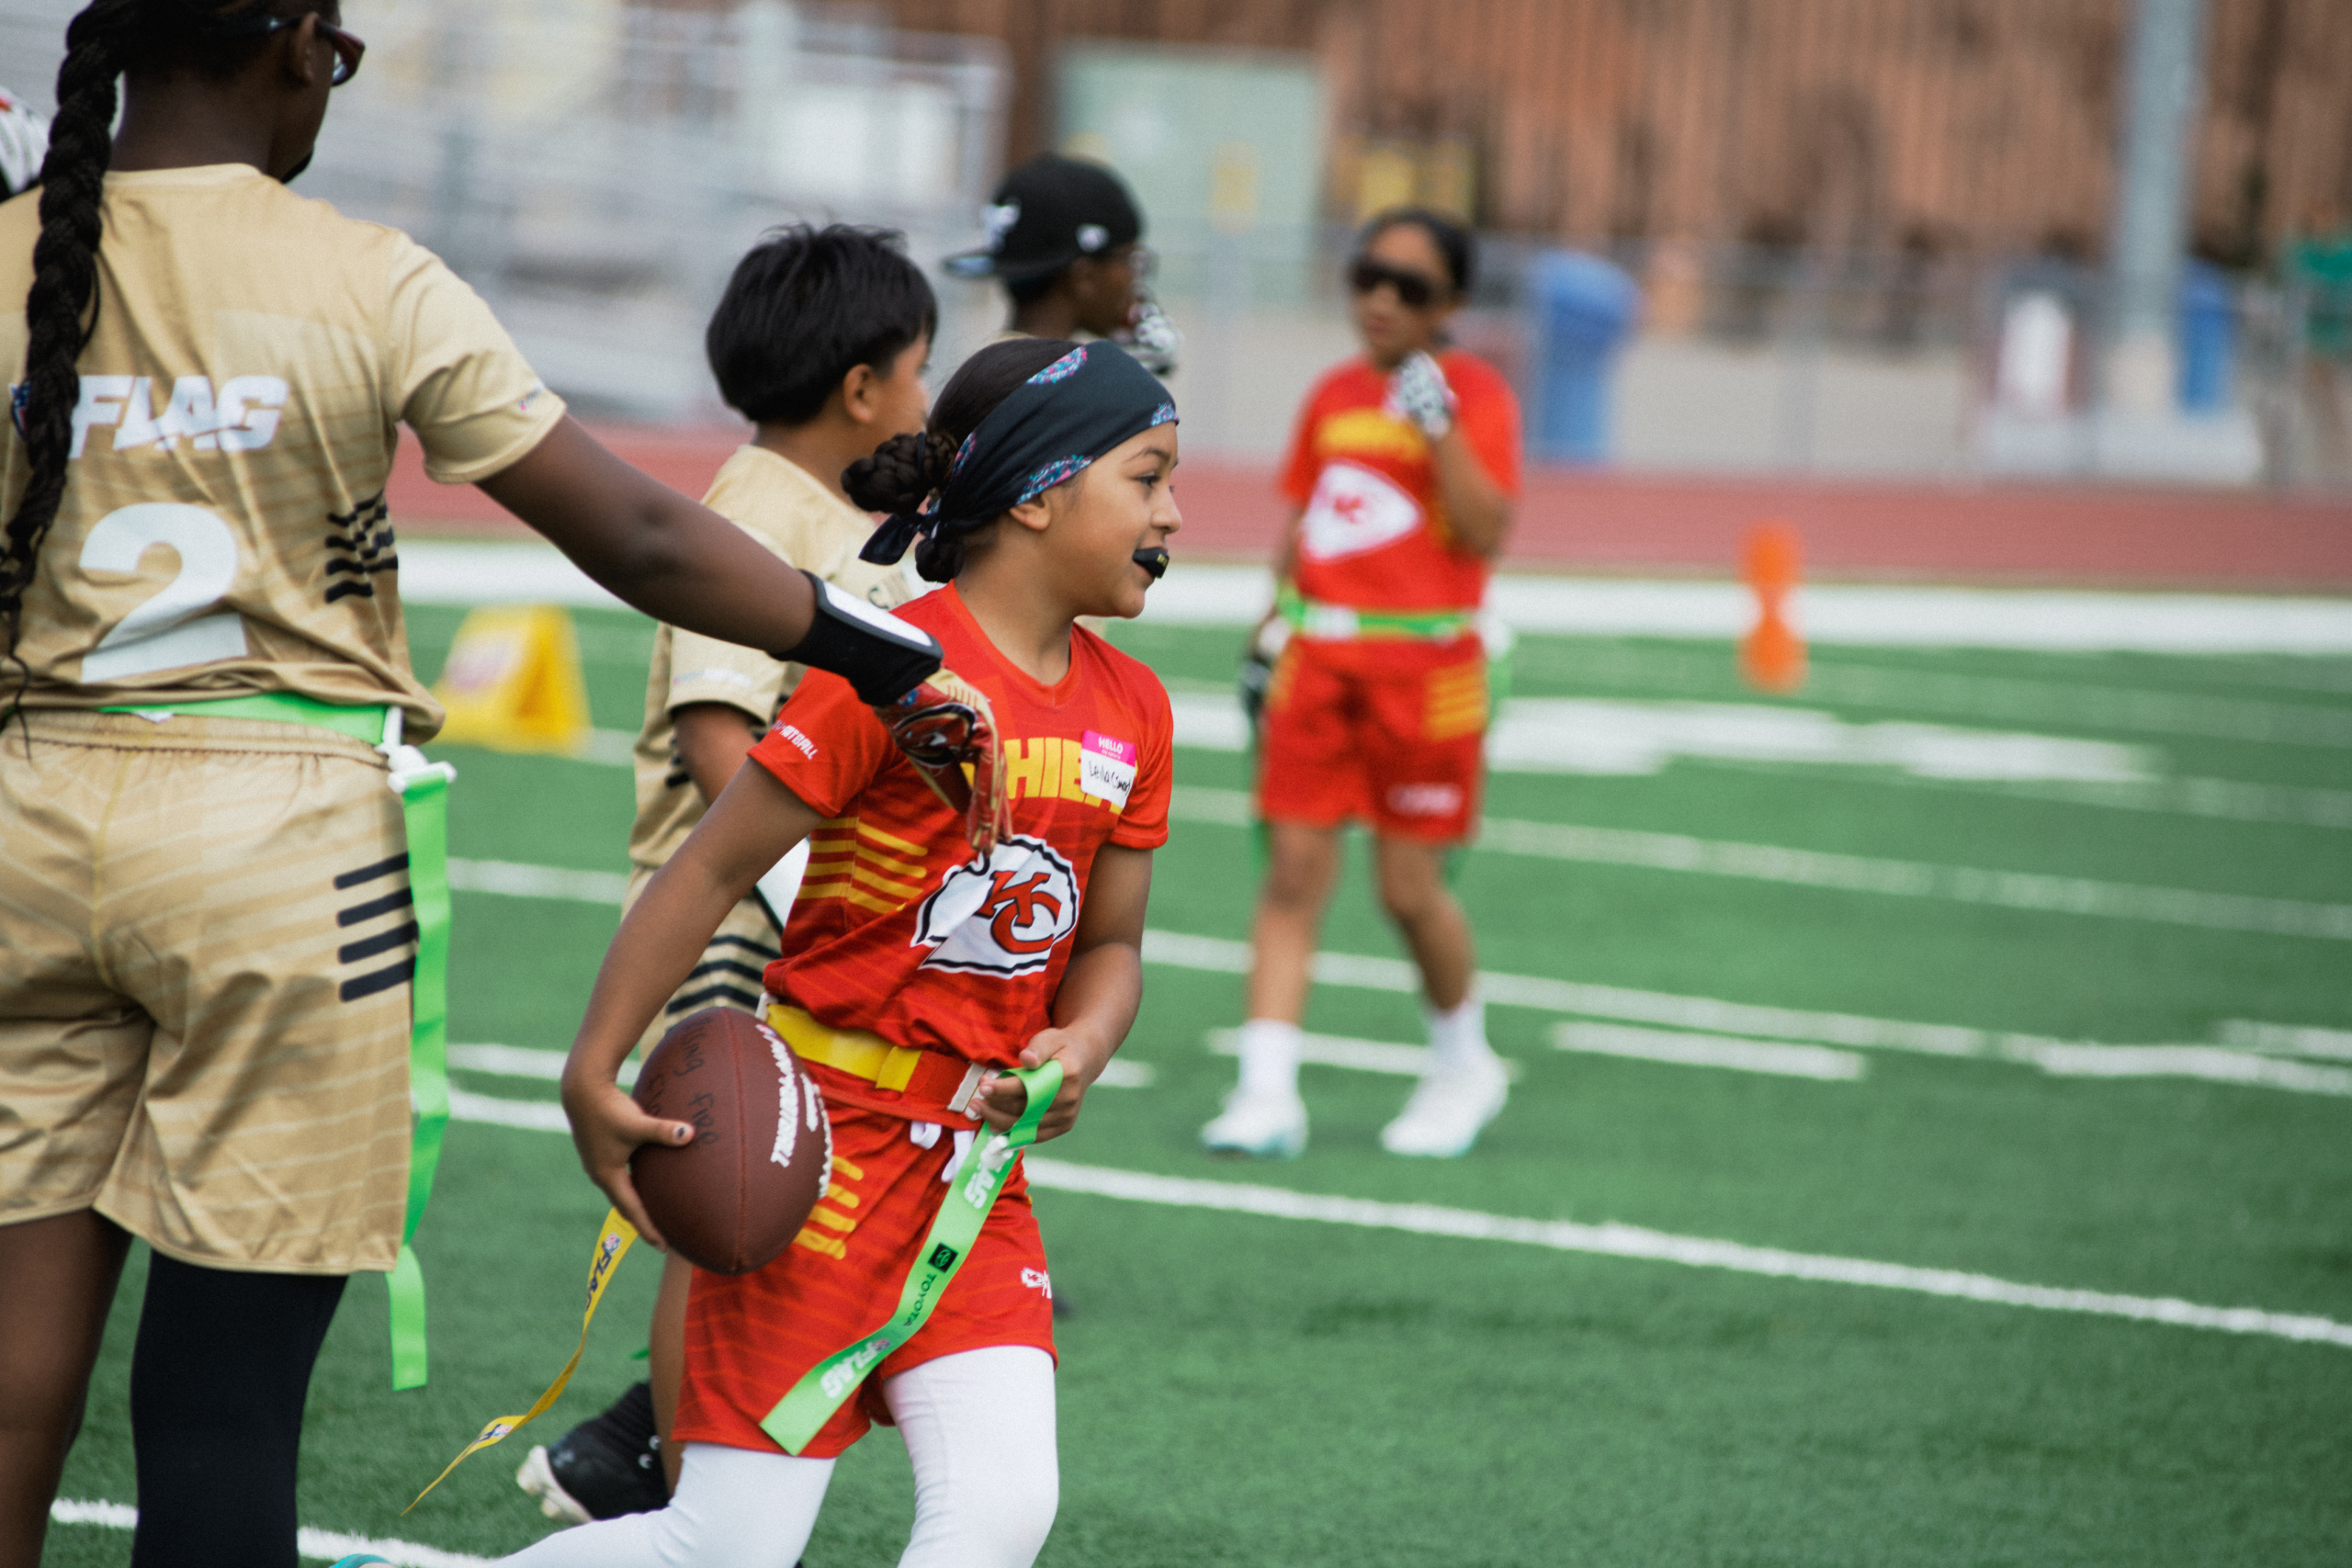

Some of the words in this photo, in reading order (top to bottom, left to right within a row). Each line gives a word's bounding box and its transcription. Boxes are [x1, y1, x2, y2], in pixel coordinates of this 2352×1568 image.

[68, 375, 289, 459] FLAG
[79, 502, 248, 684] 2
[961, 738, 1136, 816] HIE
[1098, 736, 1124, 754] HELLO
[974, 870, 1062, 954] KC
[902, 1273, 937, 1326] TOYOTA
[820, 1341, 878, 1399] FLAG
